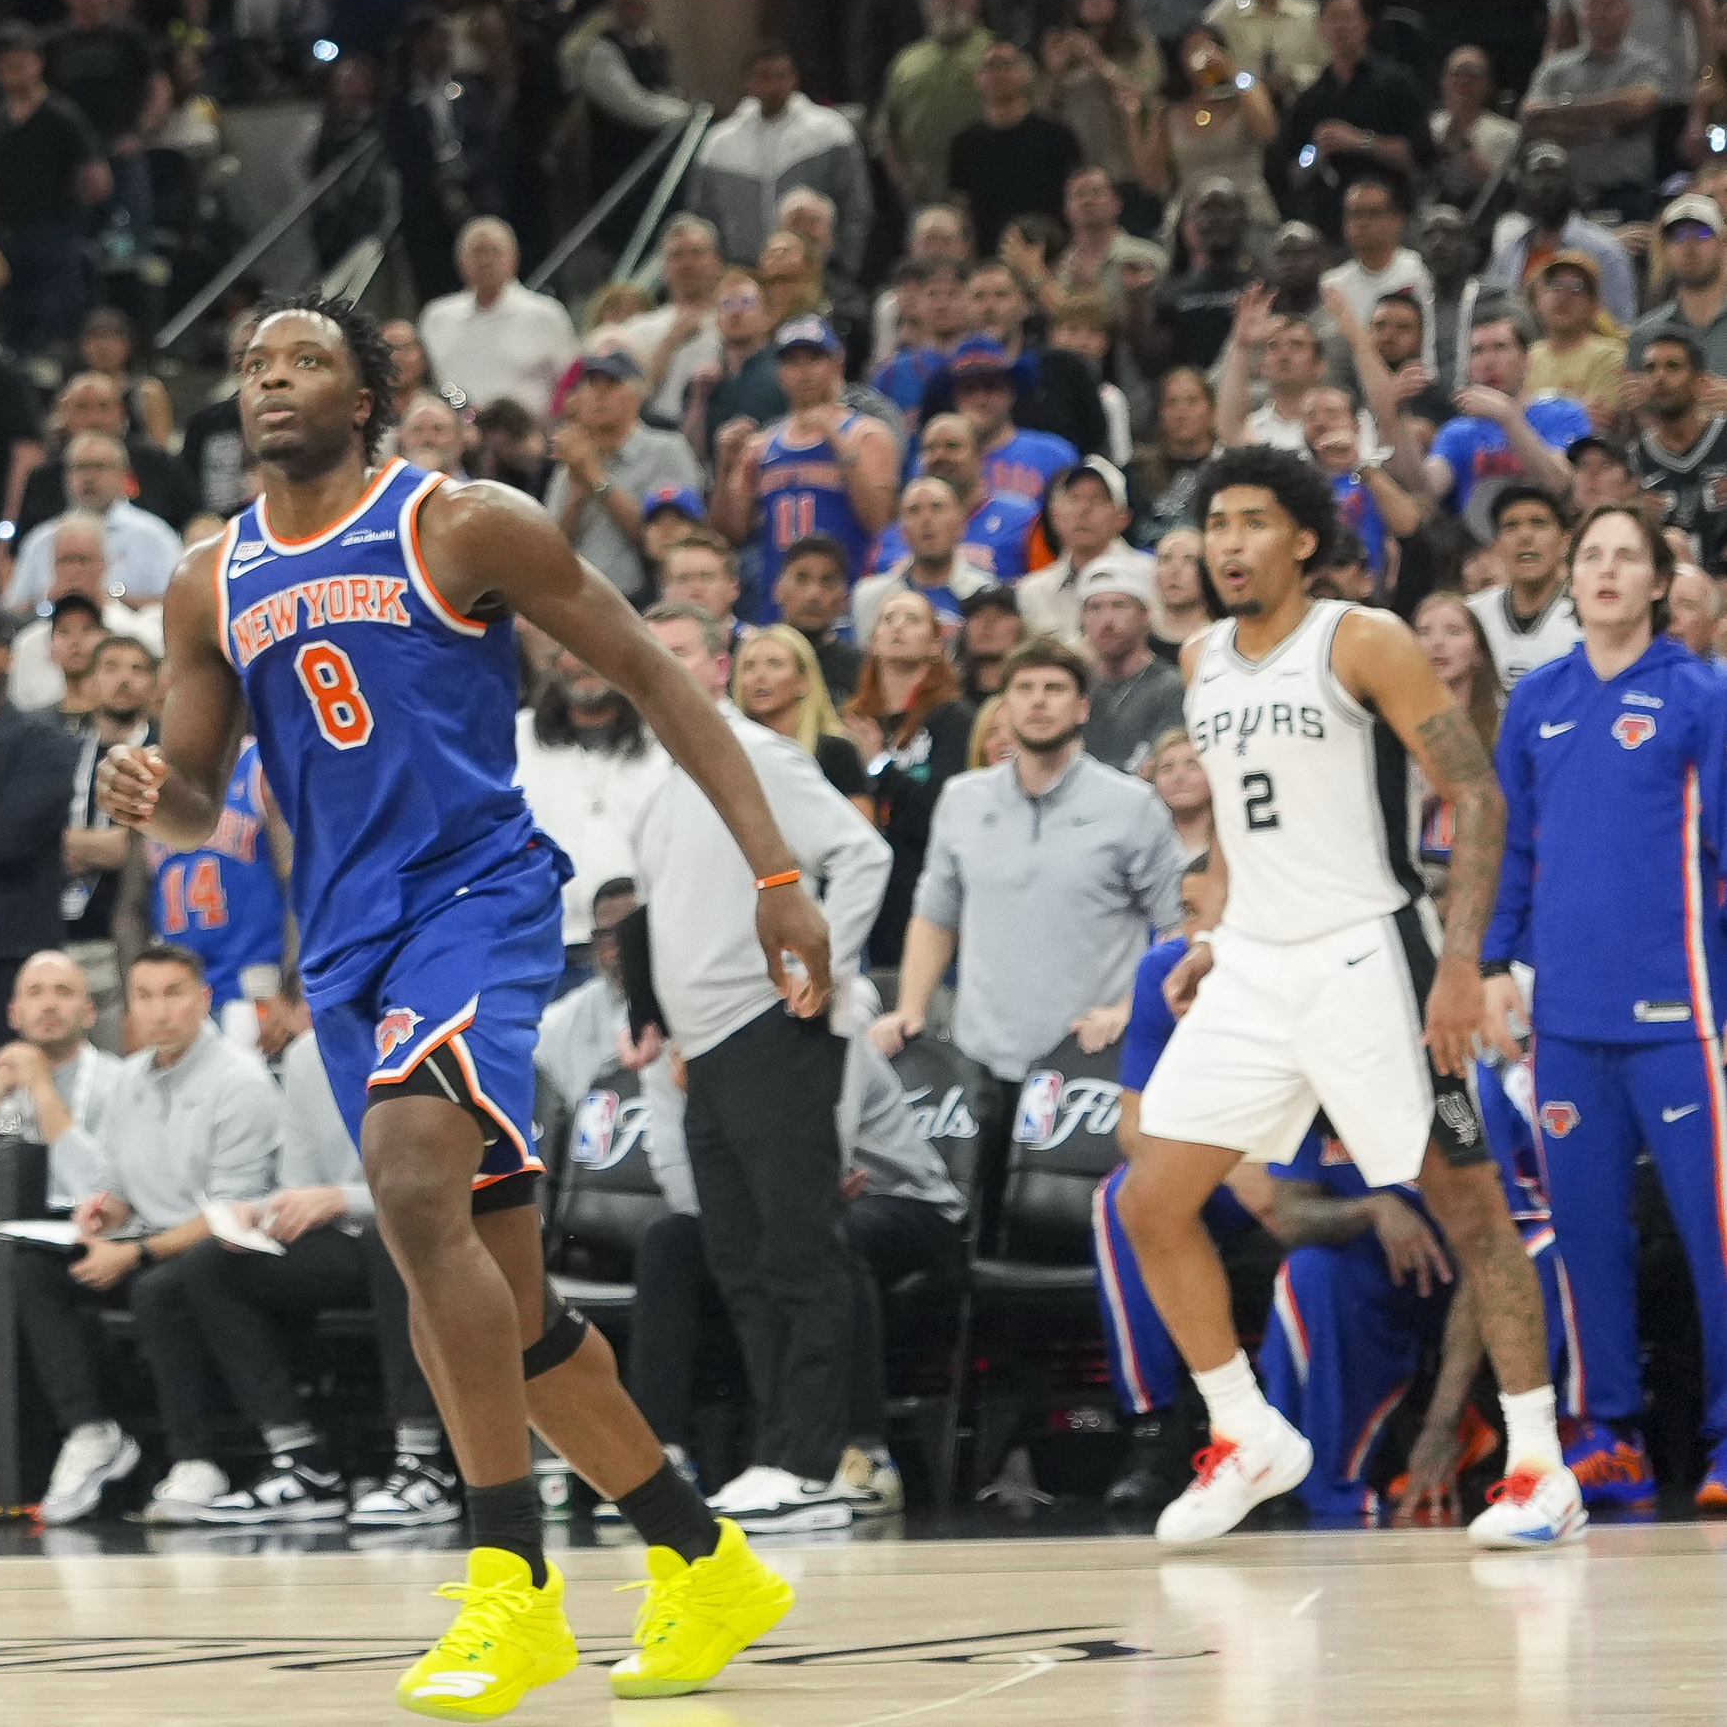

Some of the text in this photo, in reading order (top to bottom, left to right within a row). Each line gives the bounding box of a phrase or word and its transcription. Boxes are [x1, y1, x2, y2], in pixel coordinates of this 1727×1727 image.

[229, 573, 412, 670] NEW YORK
[294, 639, 375, 751] 8
[1196, 703, 1325, 758] SPURS
[1241, 770, 1281, 831] 2
[161, 856, 230, 935] 14
